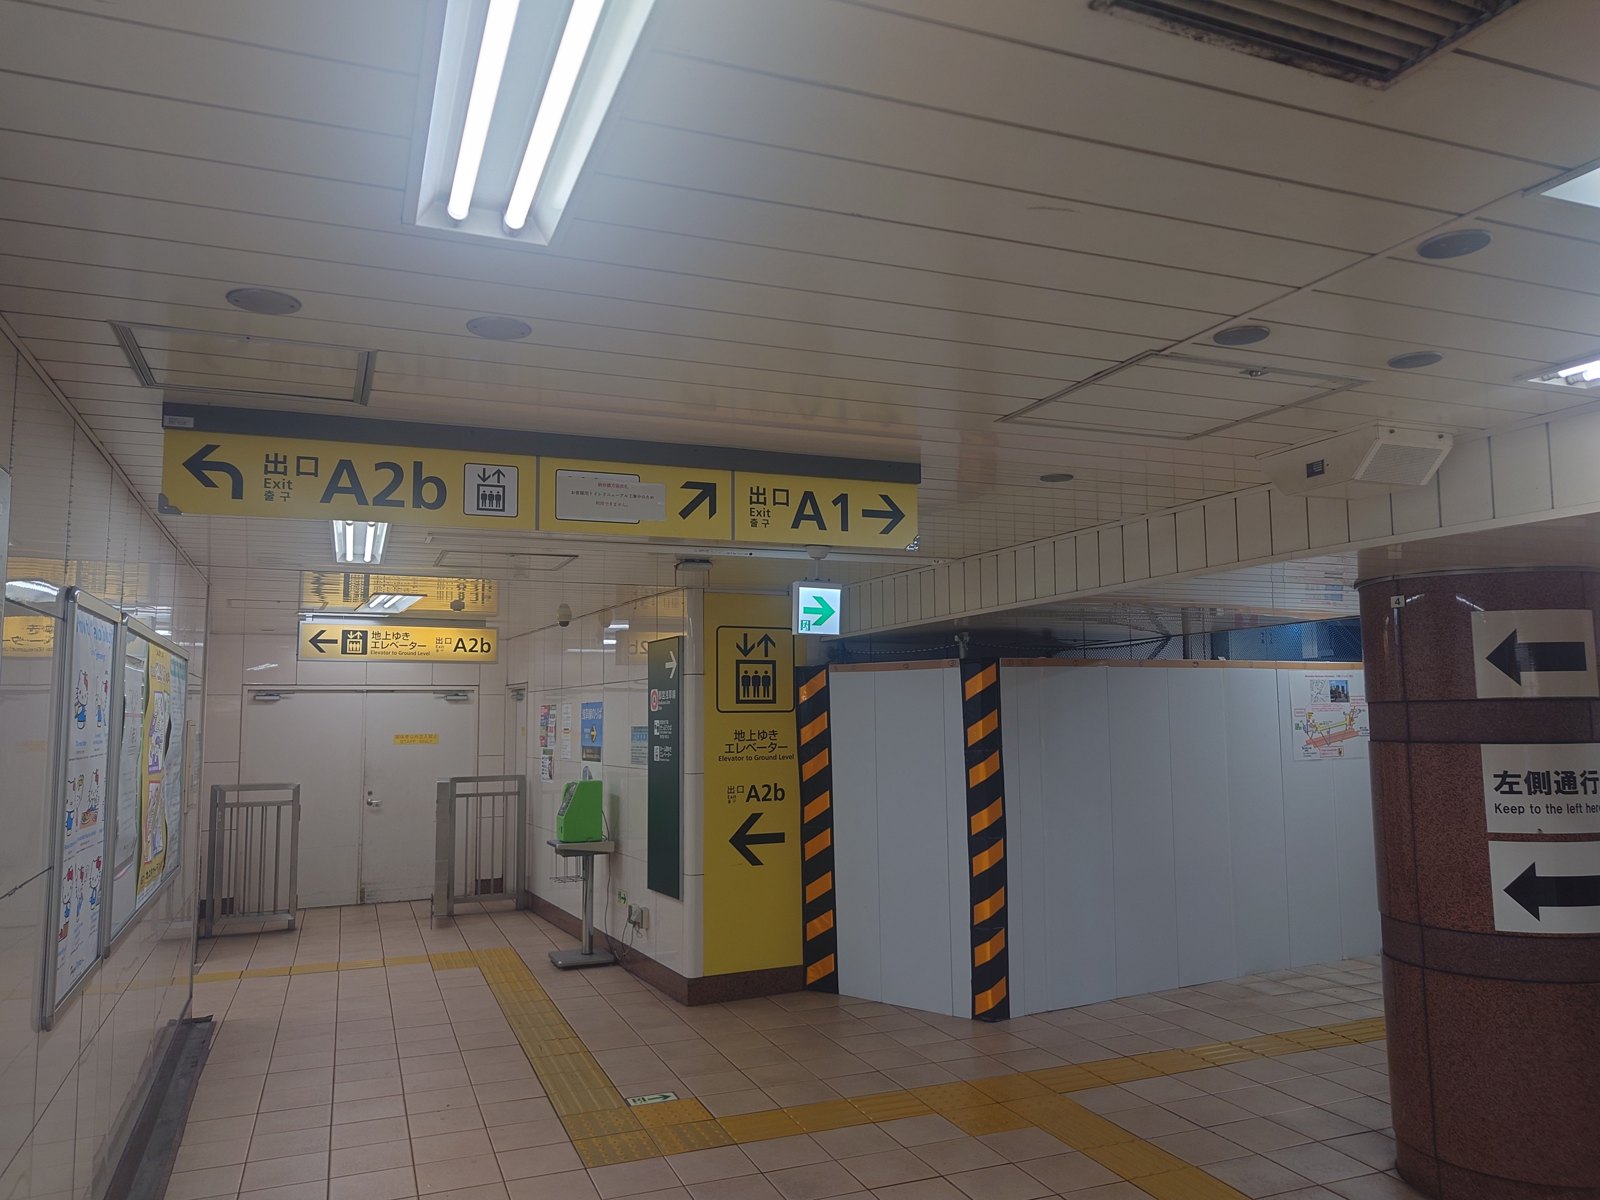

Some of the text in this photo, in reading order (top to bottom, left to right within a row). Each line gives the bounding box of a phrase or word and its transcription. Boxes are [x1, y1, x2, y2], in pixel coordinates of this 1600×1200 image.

[263, 452, 320, 478] 出口
[263, 477, 293, 491] Exit
[319, 458, 448, 510] A2b
[749, 486, 790, 508] 出口
[749, 507, 771, 519] Exit
[790, 490, 850, 532] A1
[1394, 597, 1401, 606] 4
[371, 630, 411, 641] 地上ゆき
[435, 637, 452, 645] 出口
[370, 640, 427, 650] エレベーター
[453, 636, 492, 654] A2b
[733, 729, 779, 742] 地上ゆき
[724, 742, 789, 754] エレベーター
[727, 785, 745, 794] 出口
[1493, 770, 1600, 796] 左側通行
[745, 782, 786, 803] A2b
[1494, 803, 1526, 816] Keep
[1529, 803, 1542, 815] to
[1545, 803, 1563, 815] the
[1566, 803, 1583, 815] left
